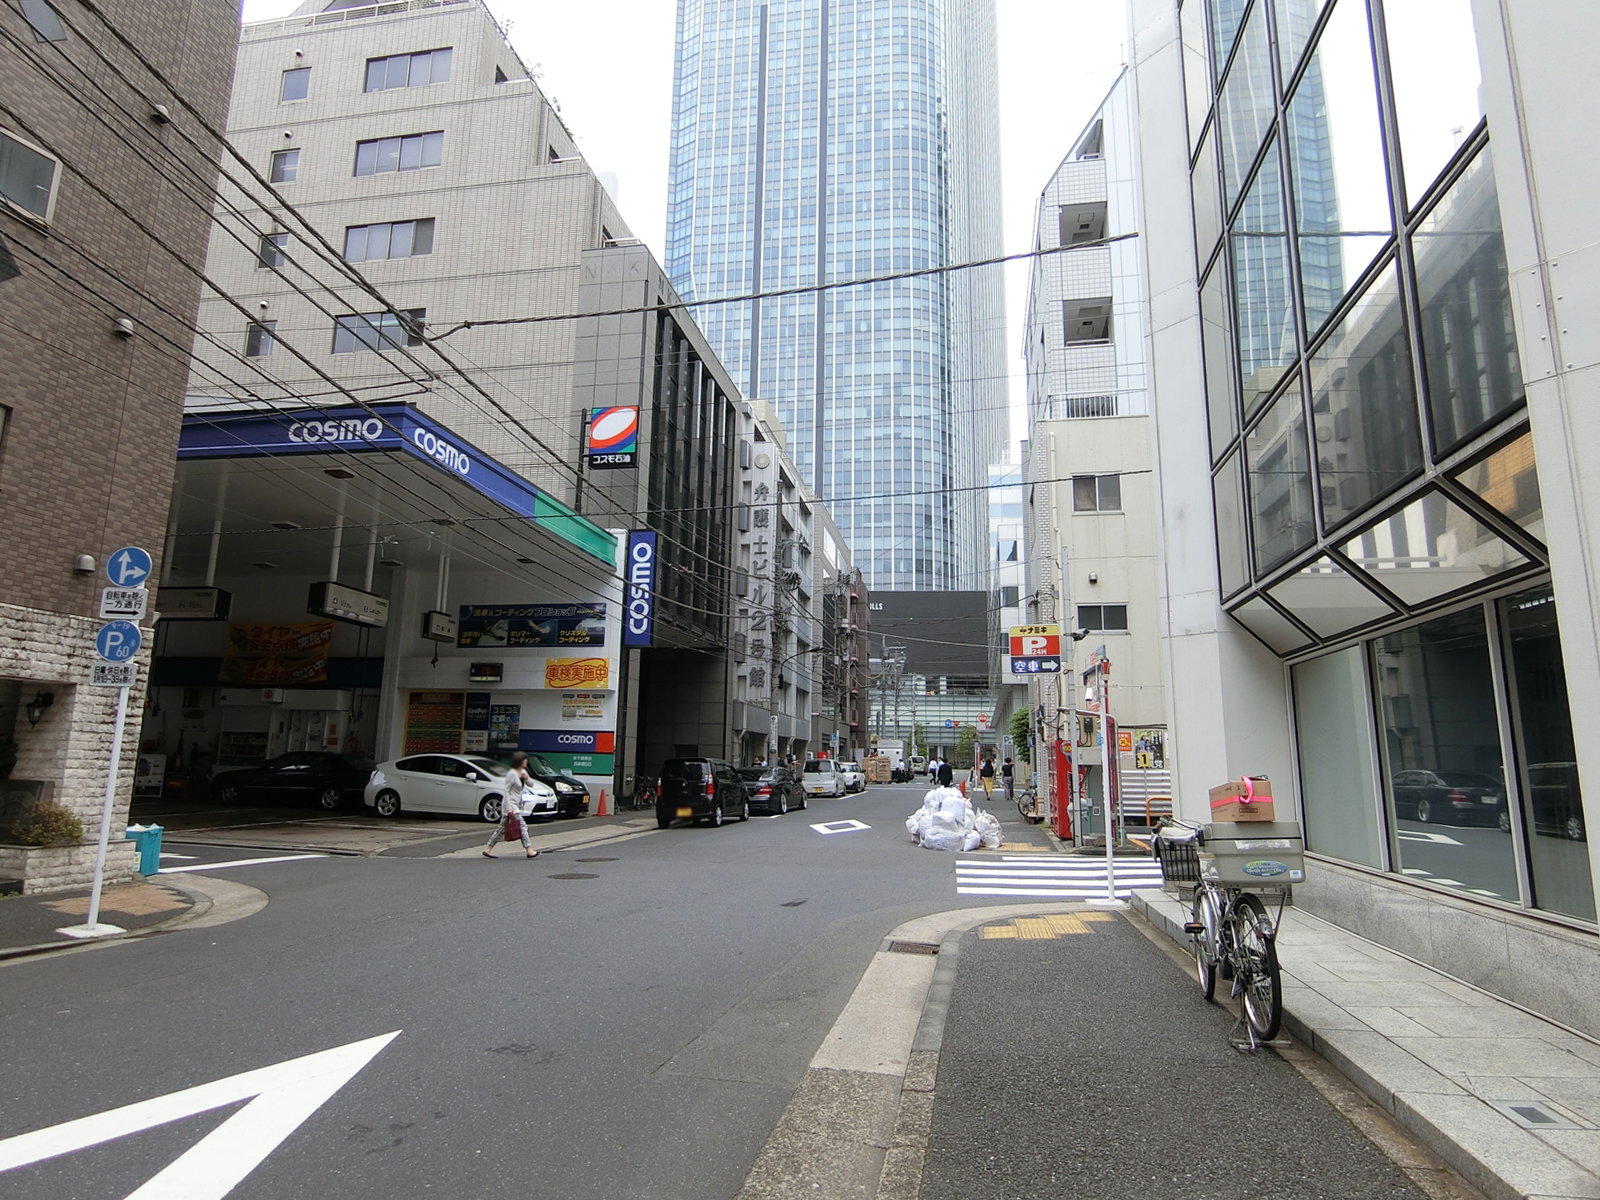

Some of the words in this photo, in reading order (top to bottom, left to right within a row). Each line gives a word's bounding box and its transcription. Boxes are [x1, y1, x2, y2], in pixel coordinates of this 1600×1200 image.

[288, 418, 383, 442] COSMO
[414, 427, 470, 475] COSMO
[592, 454, 631, 464] コスモ石油
[629, 542, 652, 634] COSMO
[106, 591, 143, 600] 自転車を除く
[105, 600, 142, 609] 一方通行
[1027, 626, 1047, 634] ナミキ
[104, 631, 124, 657] P
[1022, 636, 1047, 655] P
[1014, 660, 1040, 673] 空車
[547, 666, 608, 680] 車検実施中
[492, 706, 518, 714] コミコミ
[557, 734, 594, 744] COSMO
[1141, 754, 1147, 765] 1
